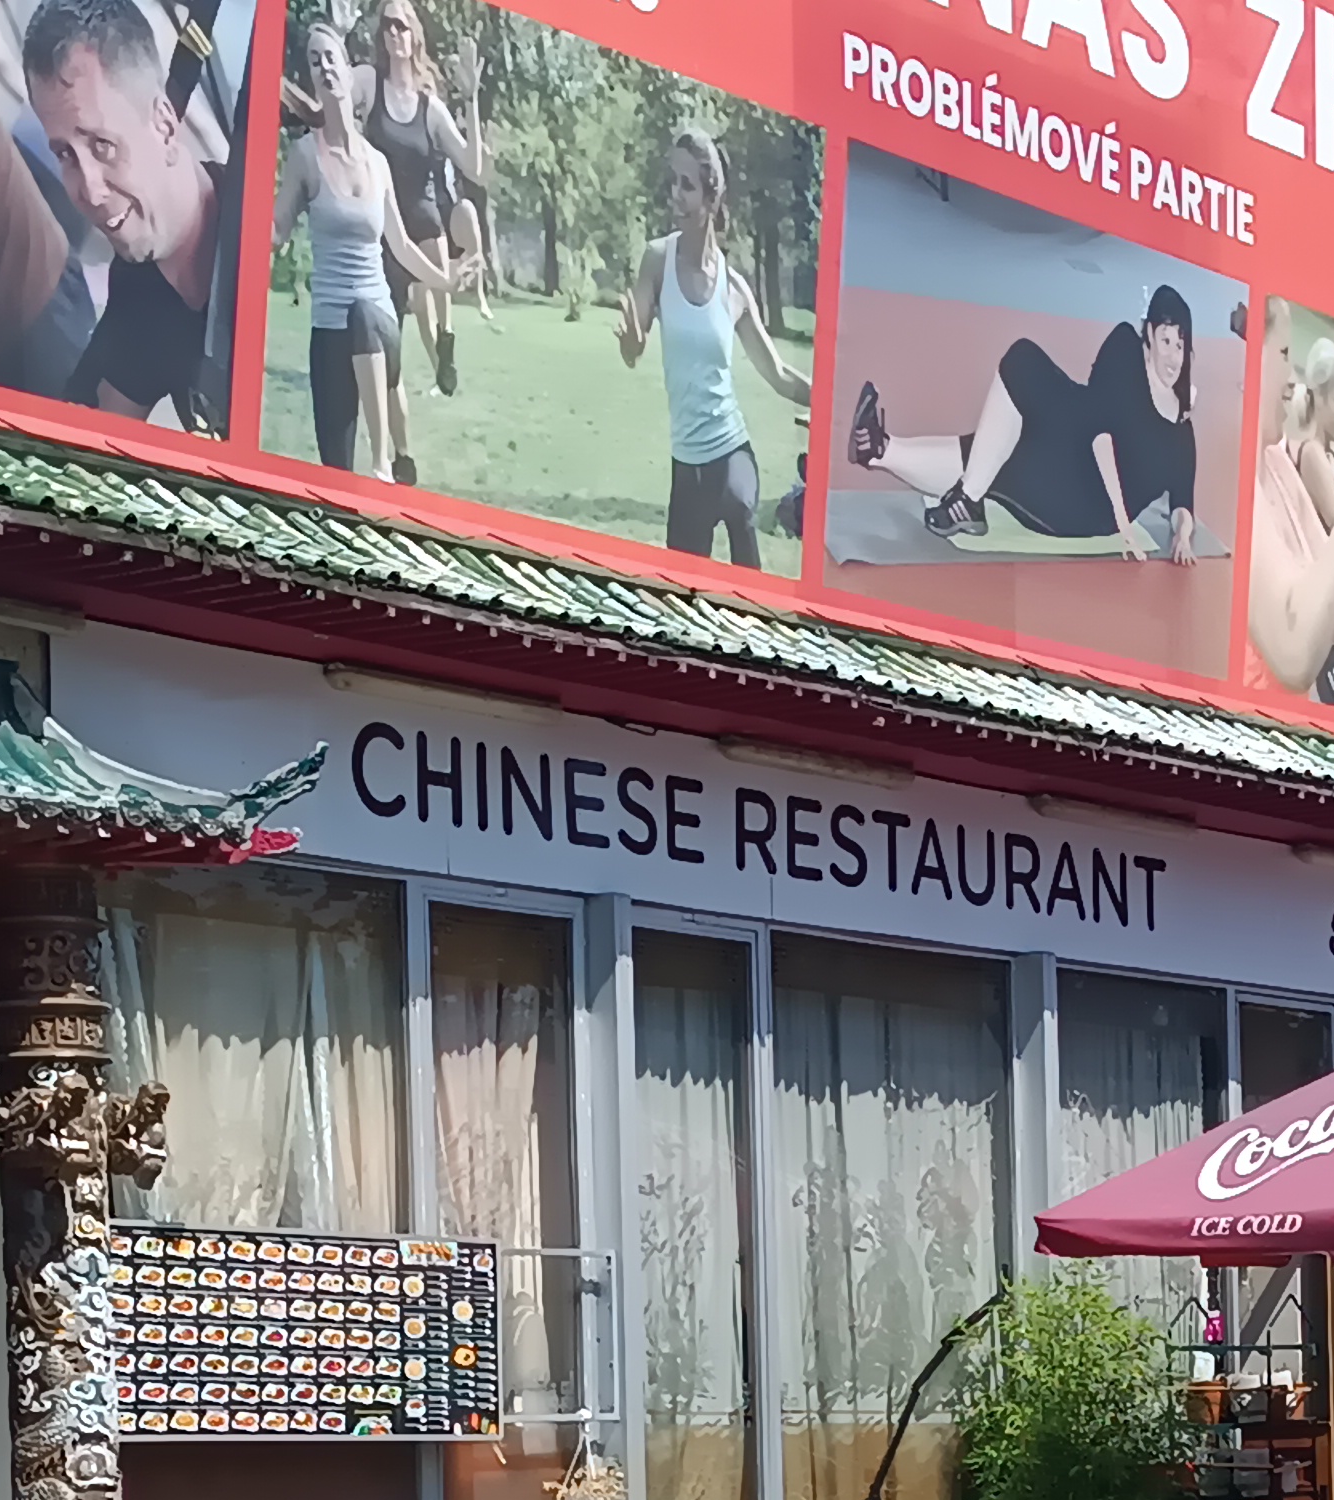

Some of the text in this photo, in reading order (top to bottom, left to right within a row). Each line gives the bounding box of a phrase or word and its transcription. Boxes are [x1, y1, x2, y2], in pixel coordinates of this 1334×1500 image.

[842, 32, 1256, 244] PROBLÉMOVÉ PARTIE
[351, 721, 1167, 932] CHINESE RESTAURANT
[1190, 1214, 1303, 1237] ICE COLD
